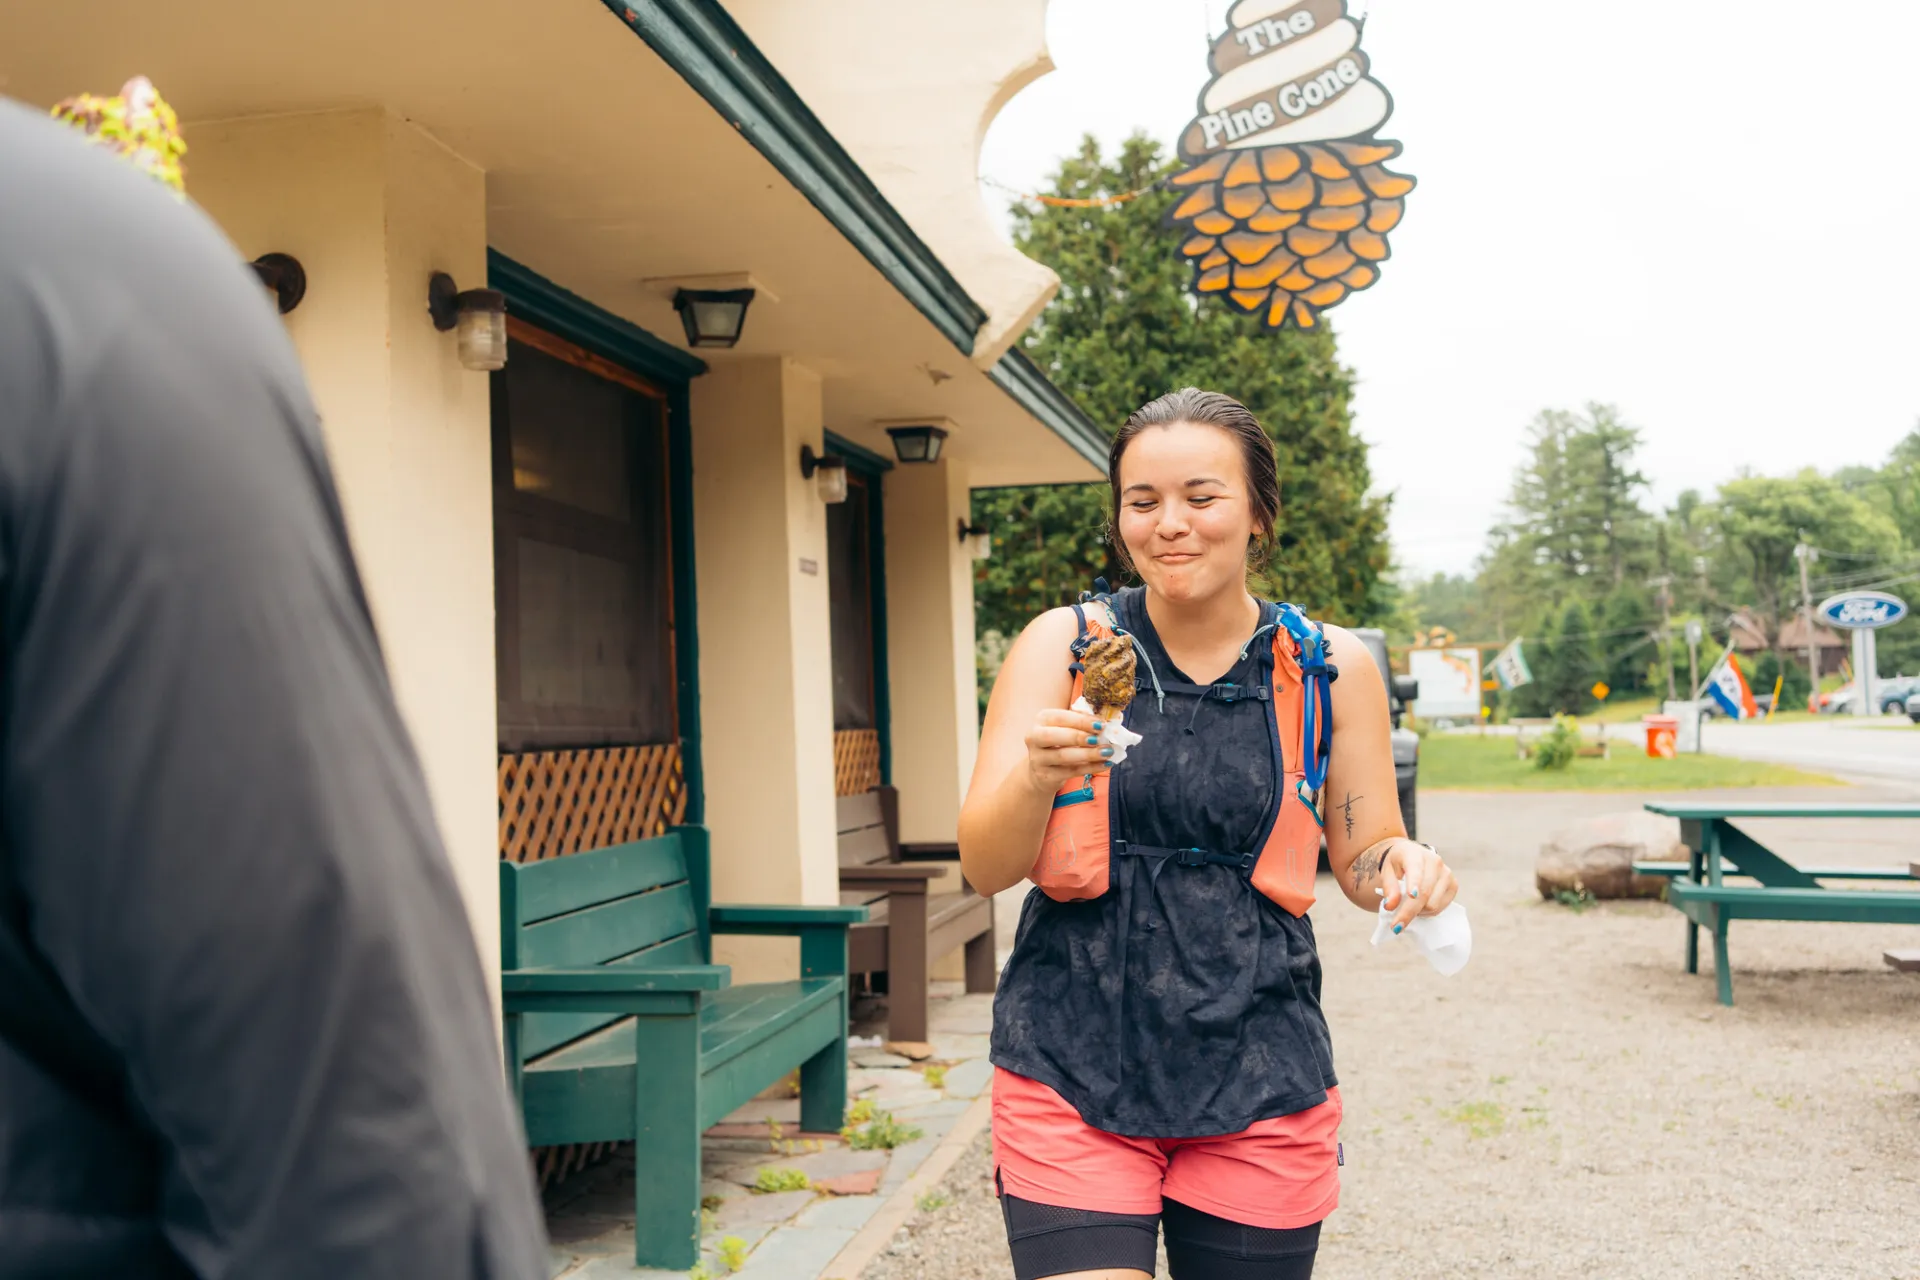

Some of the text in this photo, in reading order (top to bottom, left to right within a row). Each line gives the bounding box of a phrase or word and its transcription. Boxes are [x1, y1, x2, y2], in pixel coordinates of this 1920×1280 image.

[1237, 9, 1317, 56] The
[1198, 57, 1362, 150] Pine Cone
[1839, 600, 1889, 622] Ford
